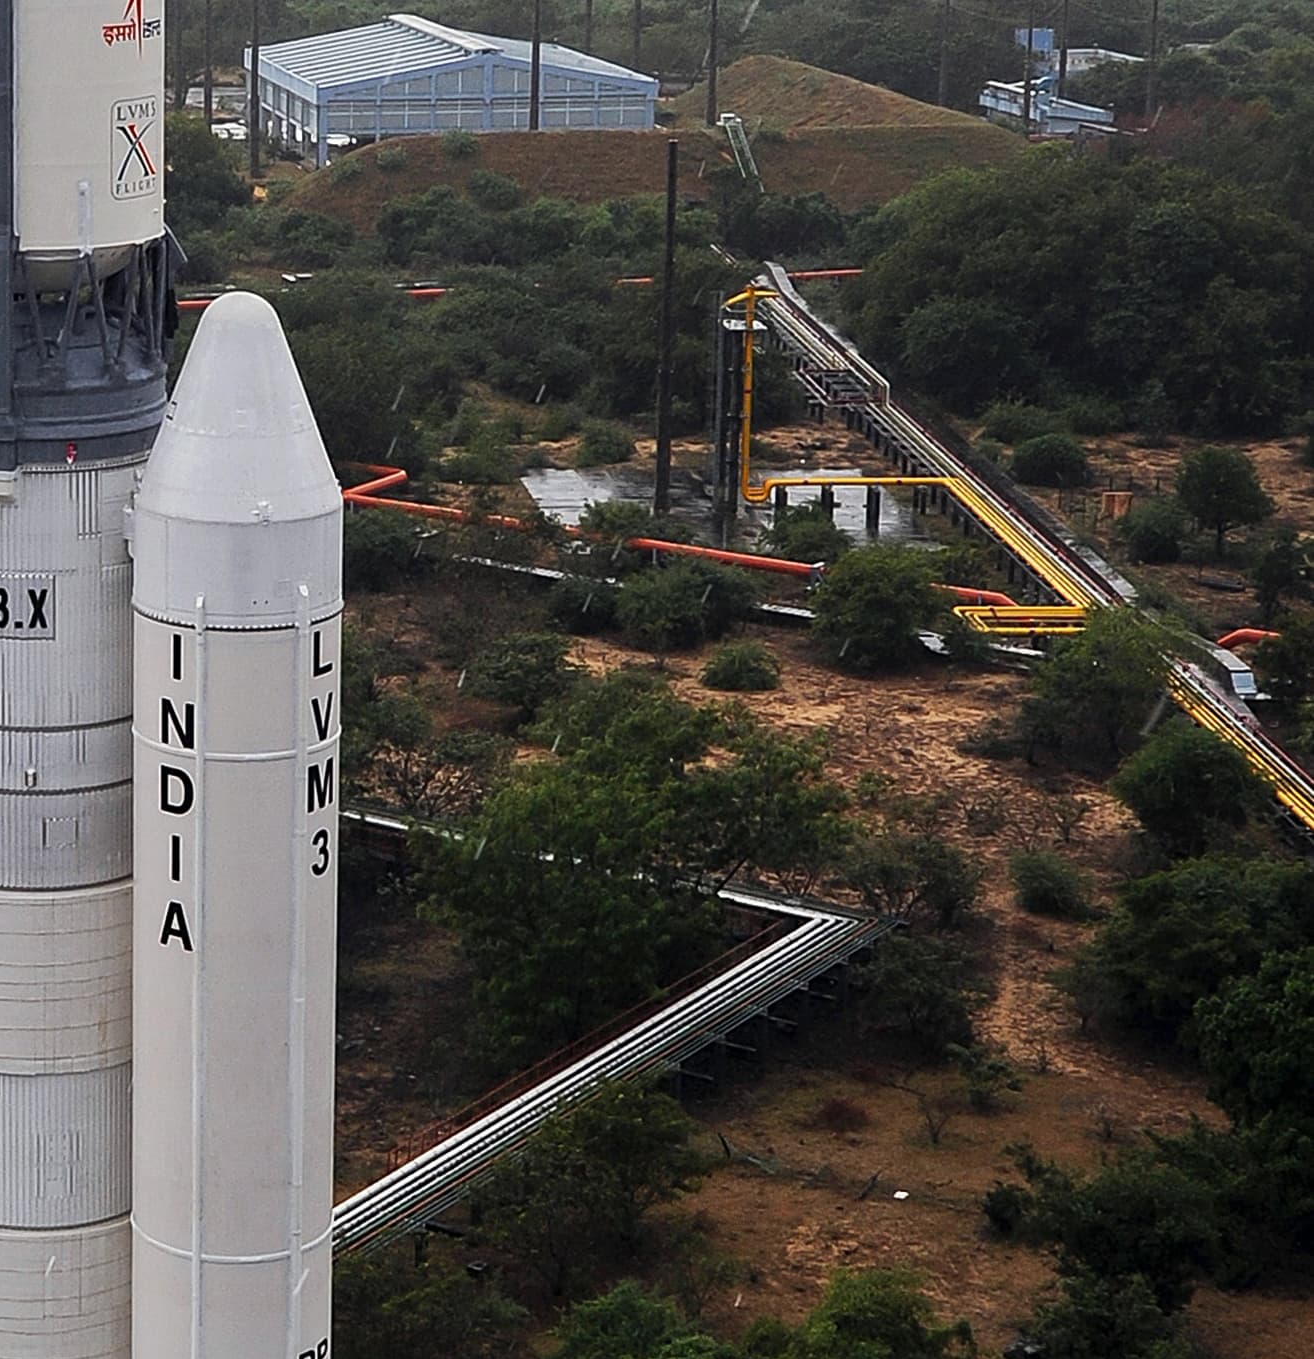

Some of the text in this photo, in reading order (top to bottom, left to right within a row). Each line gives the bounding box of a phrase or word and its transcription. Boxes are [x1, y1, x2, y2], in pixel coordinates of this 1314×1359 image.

[102, 18, 136, 47] इसरो
[160, 634, 195, 952] INDIA
[307, 630, 334, 876] LVM3
